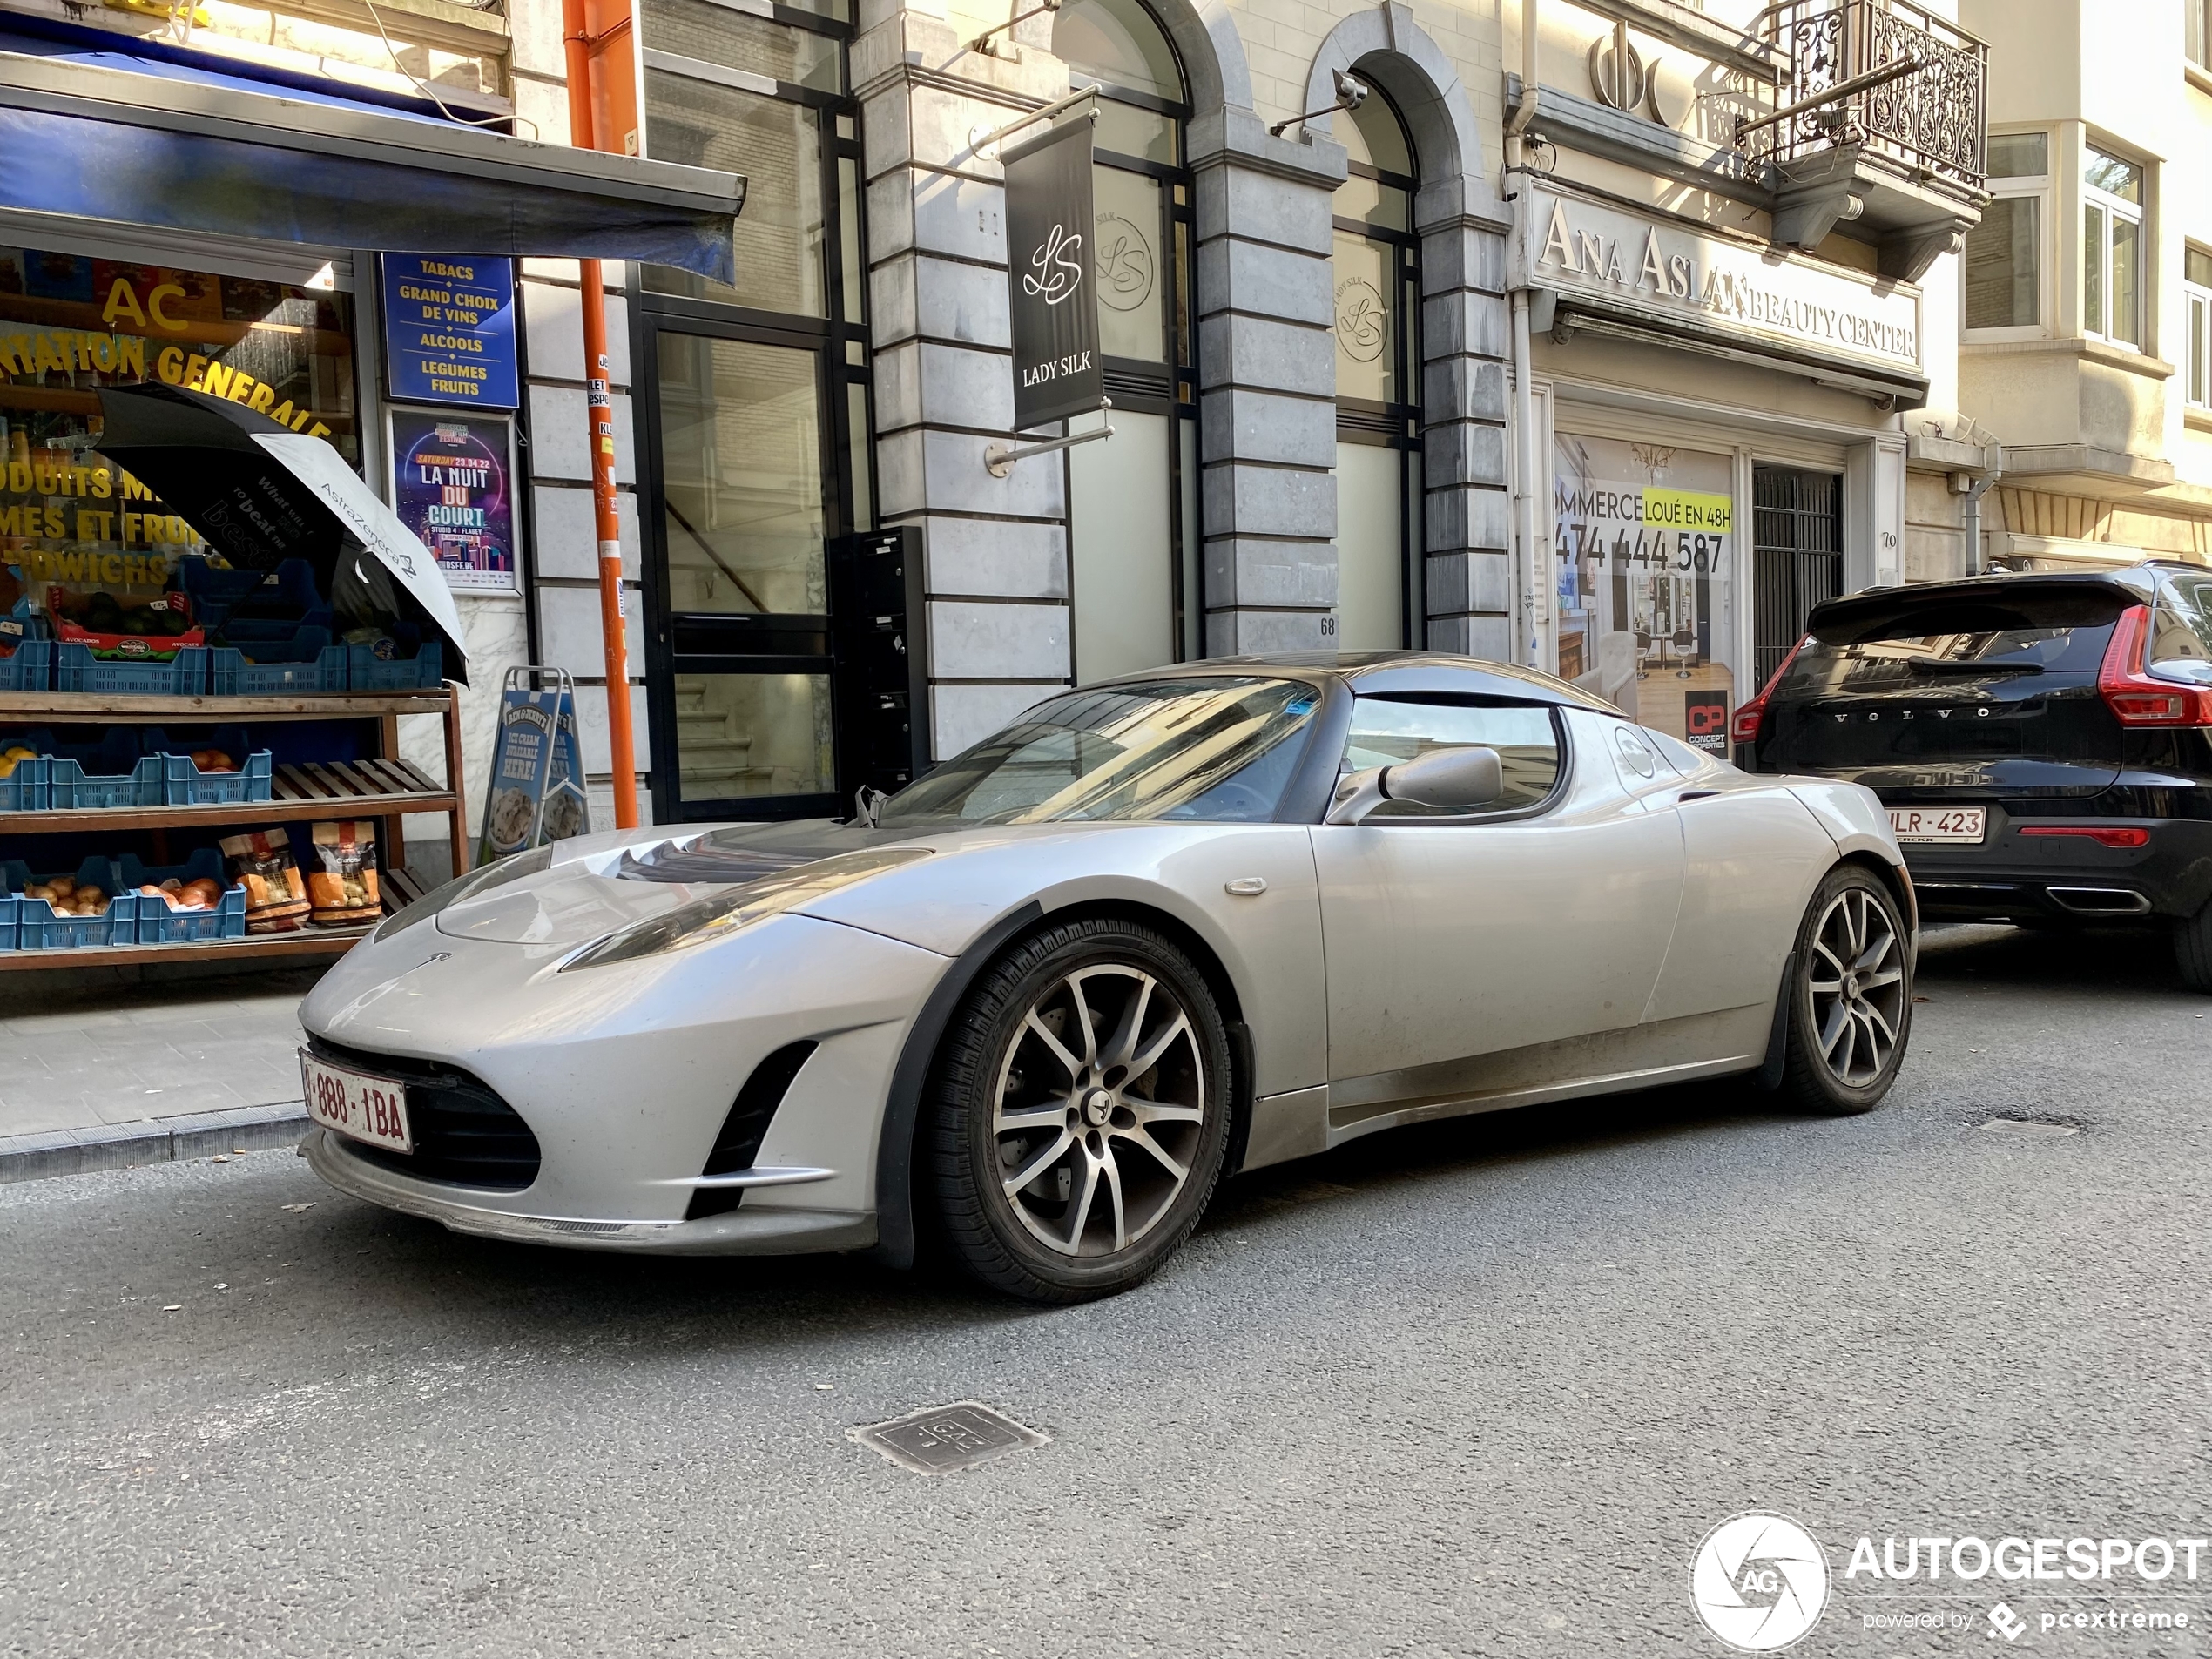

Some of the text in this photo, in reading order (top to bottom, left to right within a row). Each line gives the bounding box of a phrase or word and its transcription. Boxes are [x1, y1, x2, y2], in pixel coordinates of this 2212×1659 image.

[421, 260, 474, 280] TABACS
[1538, 197, 1918, 359] ANA ASLAN BEAUTY CENTER
[102, 278, 189, 331] AC
[399, 286, 499, 311] GRAND CHOIX
[422, 306, 479, 325] DE VINS
[421, 334, 483, 353] ALCOOLS
[421, 361, 488, 381] LEGUMES
[1022, 350, 1092, 388] LADY SILK
[431, 378, 480, 396] FRUITS
[418, 455, 489, 469] SATURDAY 23.04.22
[0, 462, 112, 499] DUITS
[421, 465, 488, 488] LA NUIT
[445, 486, 467, 505] DU
[239, 498, 277, 536] beat
[428, 505, 484, 527] COURT
[1555, 486, 1731, 529] MMERCE LOUÉ EN 48H
[77, 509, 114, 543] ET
[321, 483, 400, 565] AstraZeneca
[1614, 528, 1668, 570] 444
[1677, 532, 1723, 573] 587
[1882, 531, 1897, 548] 70
[1320, 617, 1335, 636] 68
[1689, 705, 1725, 734] CP
[1835, 707, 1990, 723] VOLVO
[508, 732, 519, 744] ICE
[518, 733, 540, 746] CREAM
[1689, 734, 1725, 744] CONCEPT
[506, 745, 539, 759] AVAILABLE
[502, 758, 536, 781] HERE!
